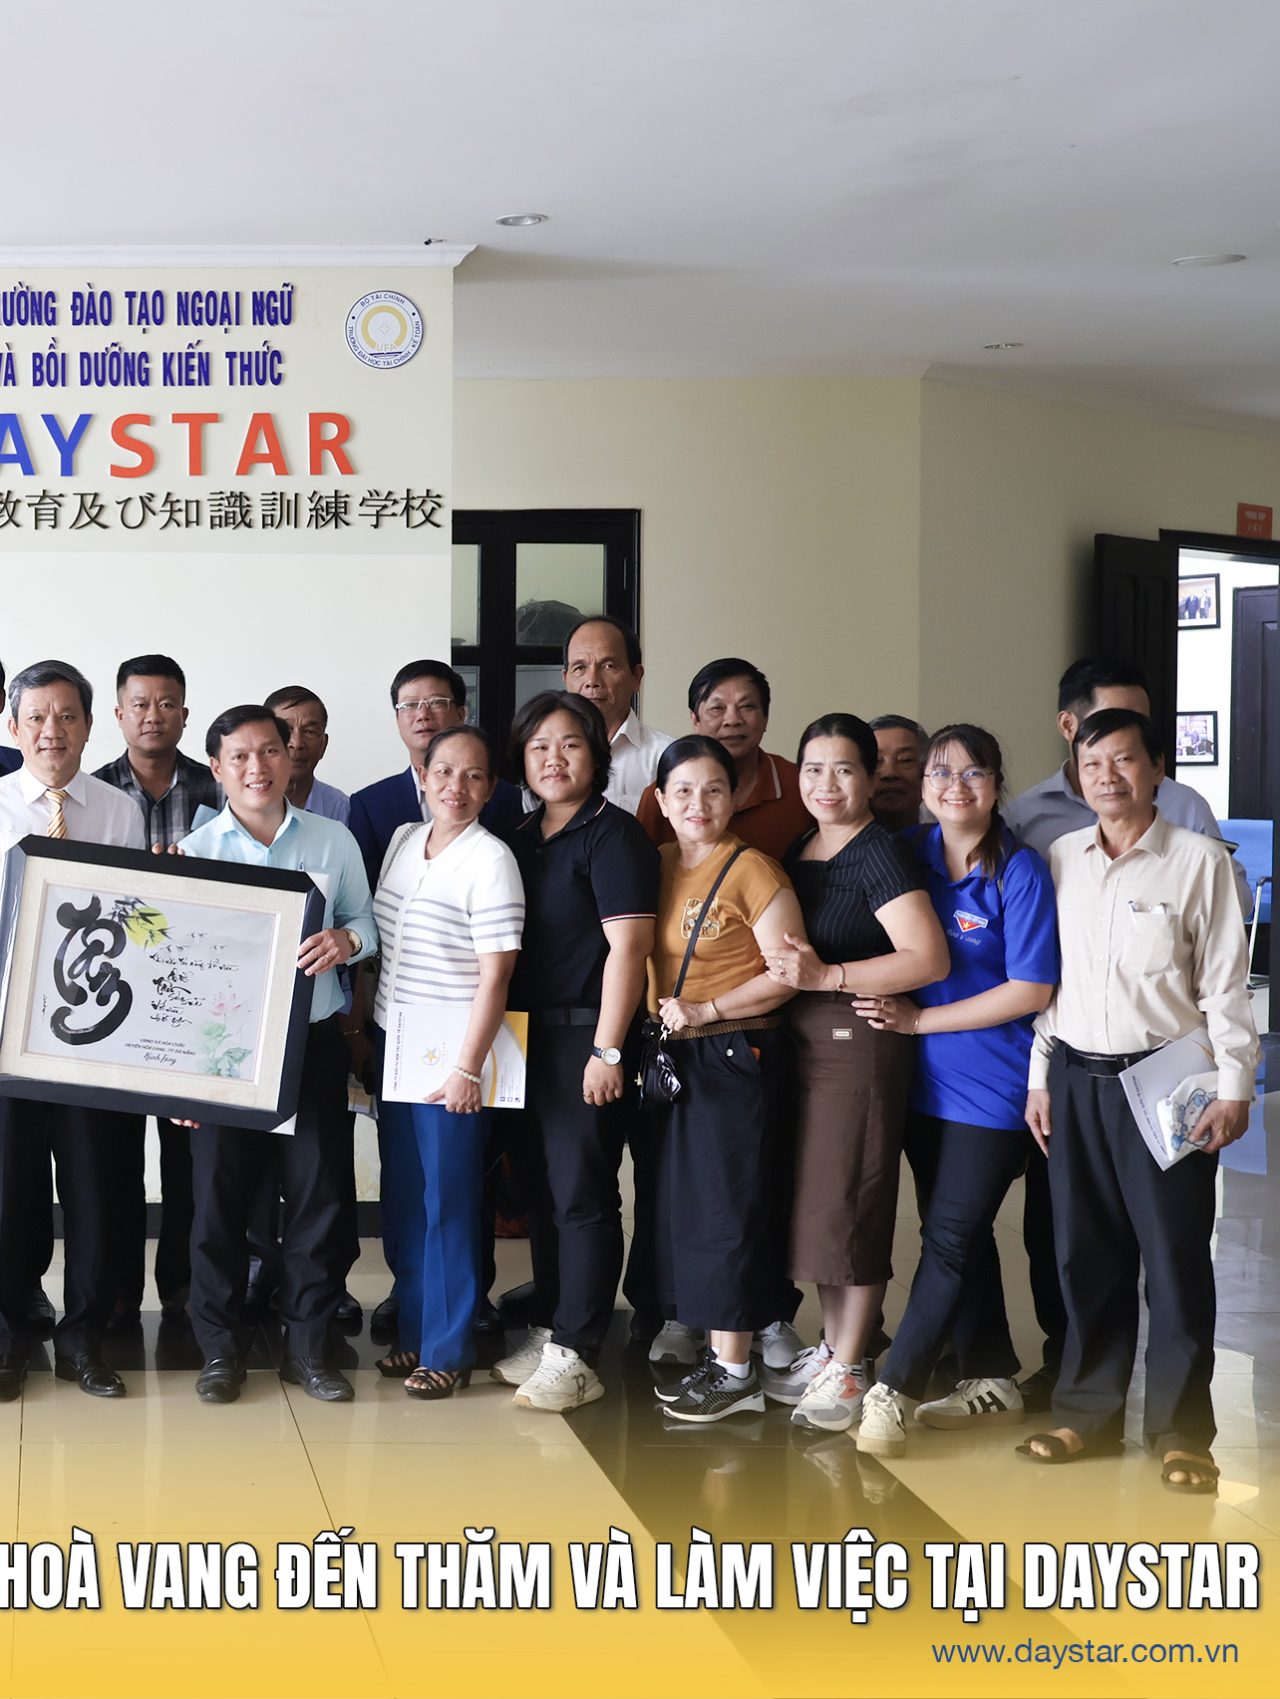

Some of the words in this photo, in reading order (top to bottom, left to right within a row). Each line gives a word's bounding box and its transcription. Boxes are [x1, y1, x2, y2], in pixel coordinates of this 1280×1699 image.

[71, 282, 113, 326] ĐÀO
[124, 290, 165, 335] TẠO
[176, 290, 241, 335] NGOẠI
[251, 282, 295, 326] NGỮ
[32, 336, 67, 387] BỒI
[79, 342, 150, 387] DƯỠNG
[162, 339, 211, 387] KIẾN
[224, 340, 283, 387] THỨC
